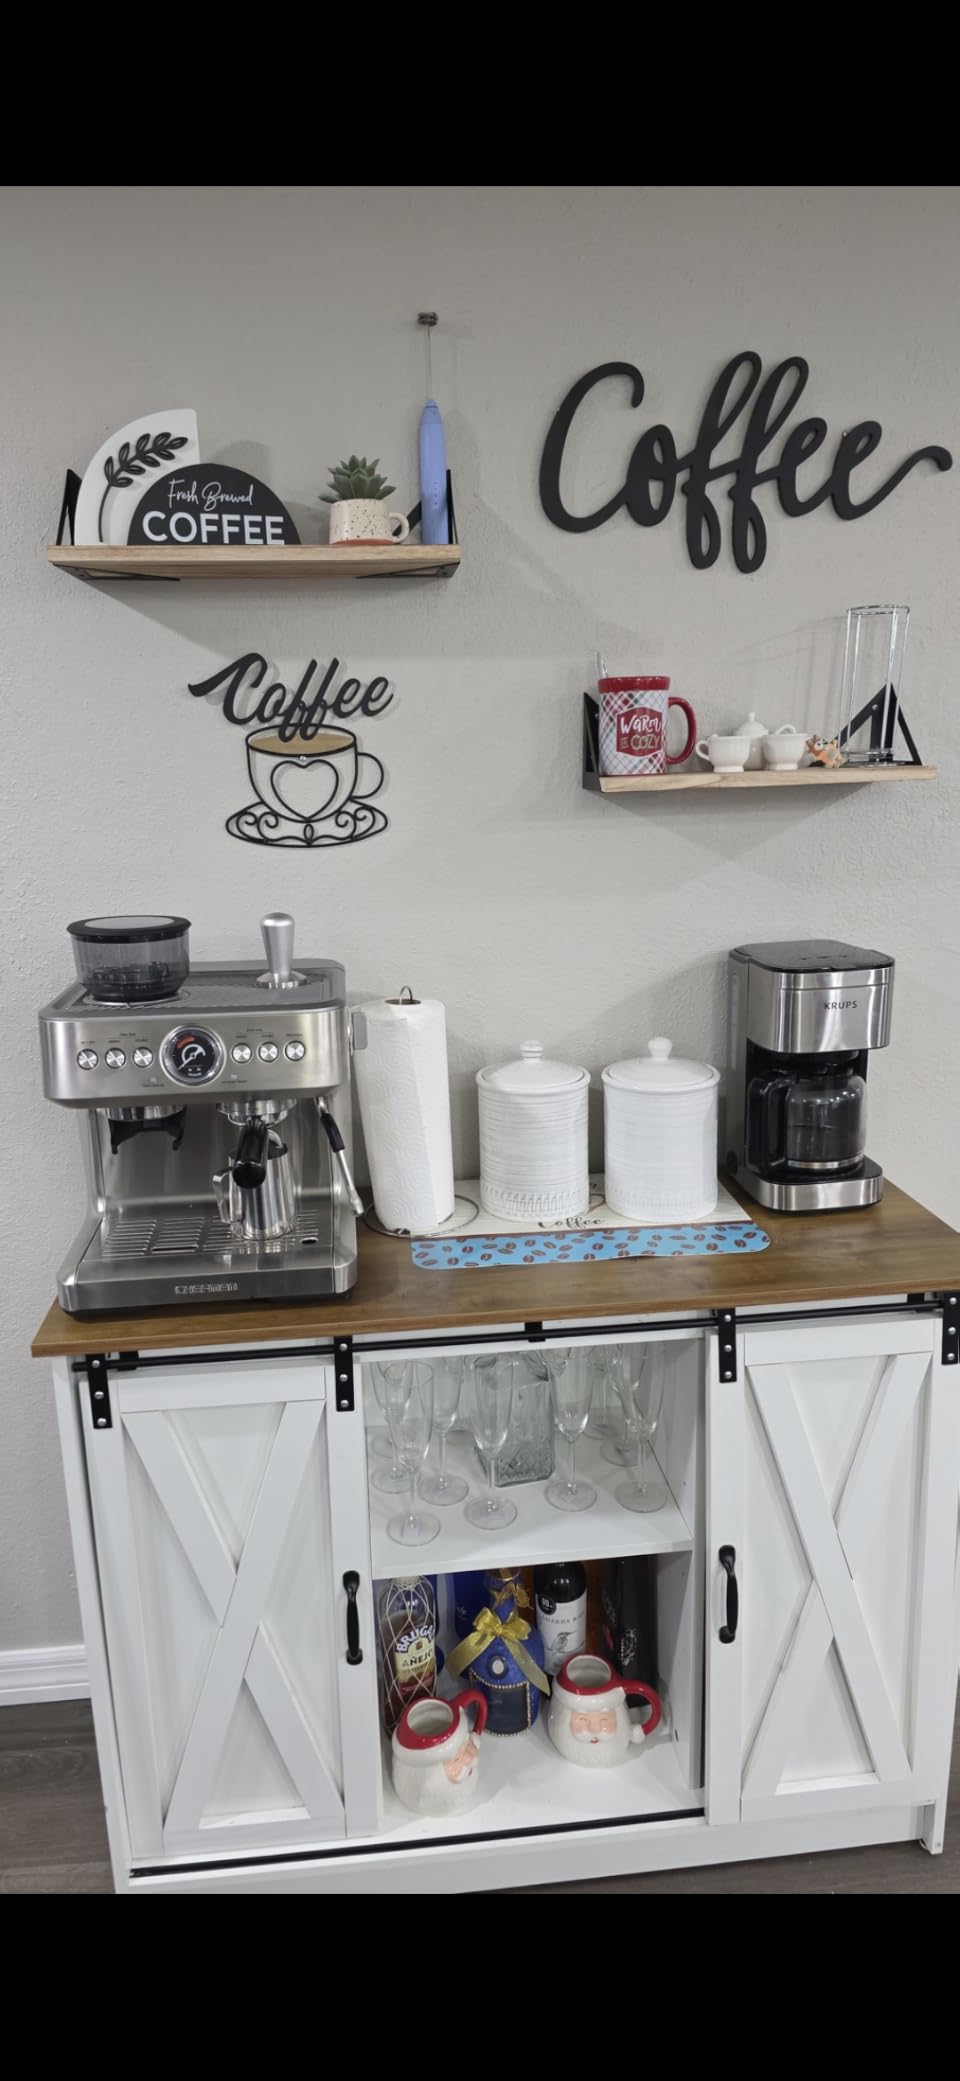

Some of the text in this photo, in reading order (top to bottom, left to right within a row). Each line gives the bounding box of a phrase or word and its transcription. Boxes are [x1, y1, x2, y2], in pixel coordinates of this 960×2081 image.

[539, 350, 953, 574] Coffee
[167, 478, 254, 512] Fresh Brewed
[142, 510, 285, 545] COFFEE
[187, 652, 394, 743] Coffee
[631, 733, 660, 751] COZY
[823, 1000, 858, 1010] KRUPS
